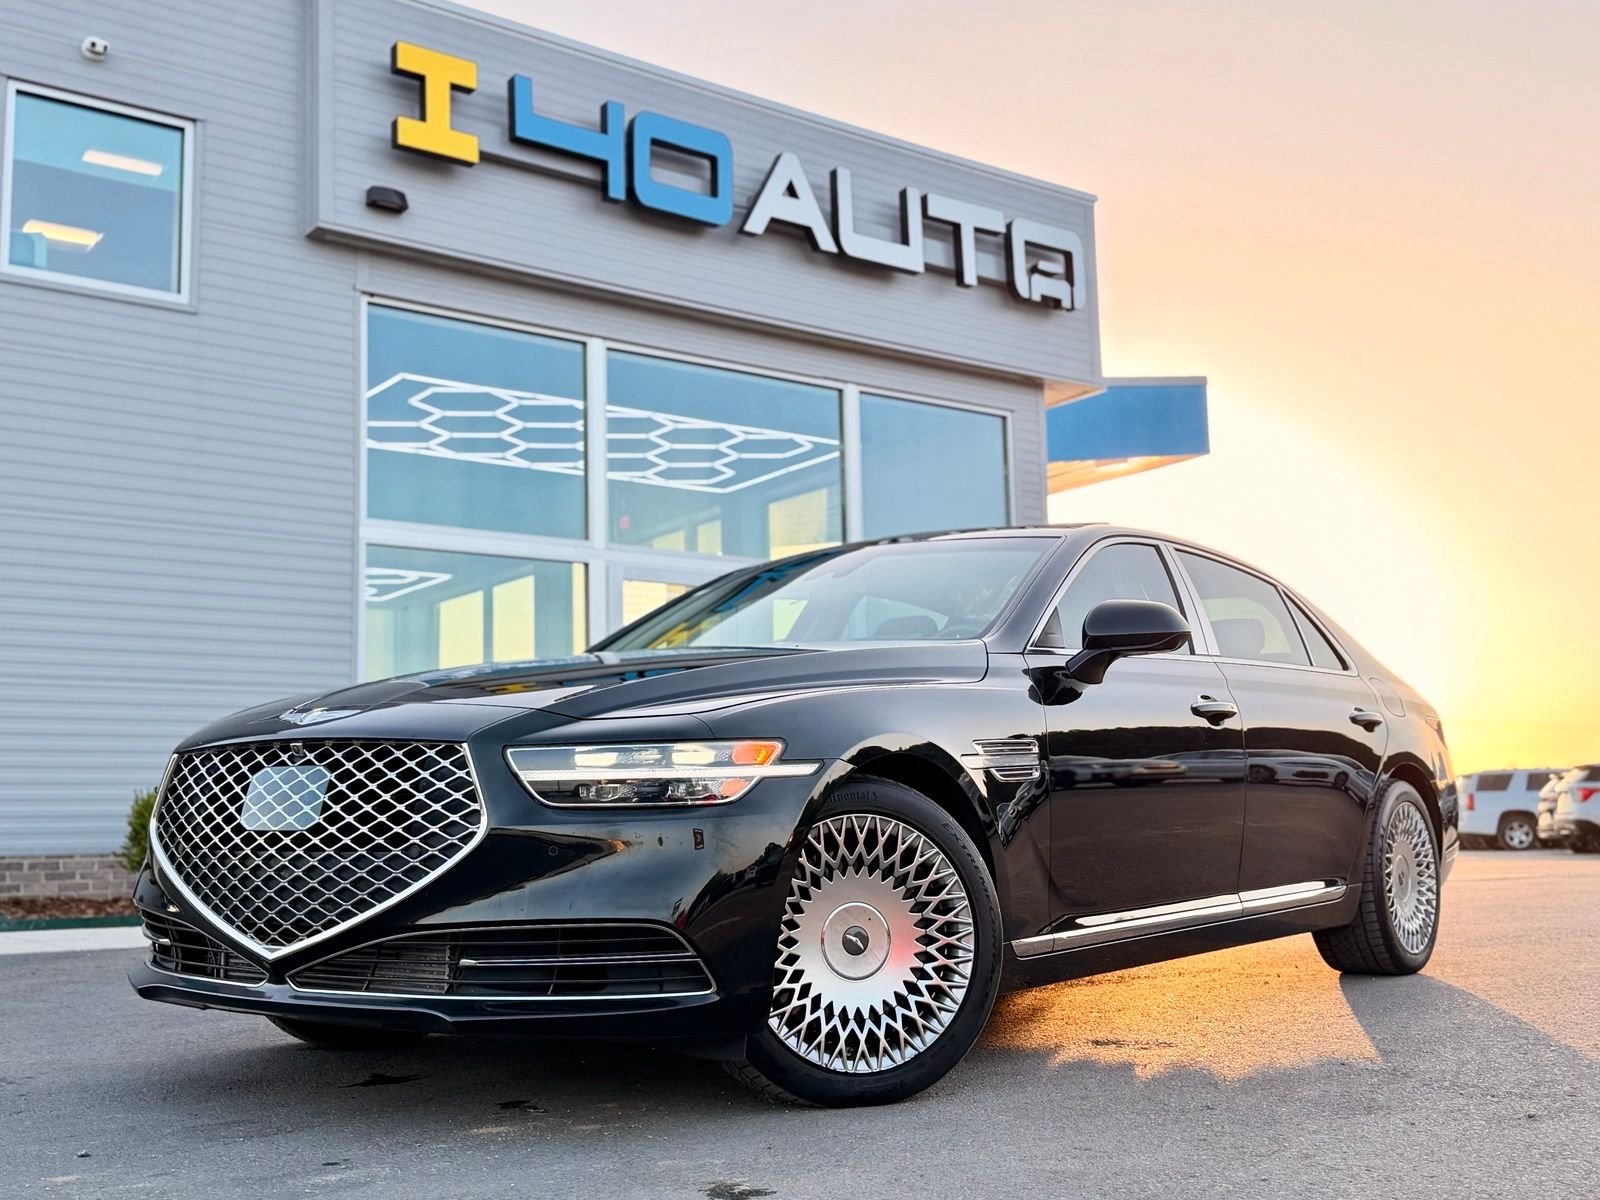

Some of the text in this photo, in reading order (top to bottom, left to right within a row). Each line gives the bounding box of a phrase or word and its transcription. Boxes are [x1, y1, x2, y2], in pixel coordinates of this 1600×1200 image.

[391, 41, 1085, 310] I 40 AUTO
